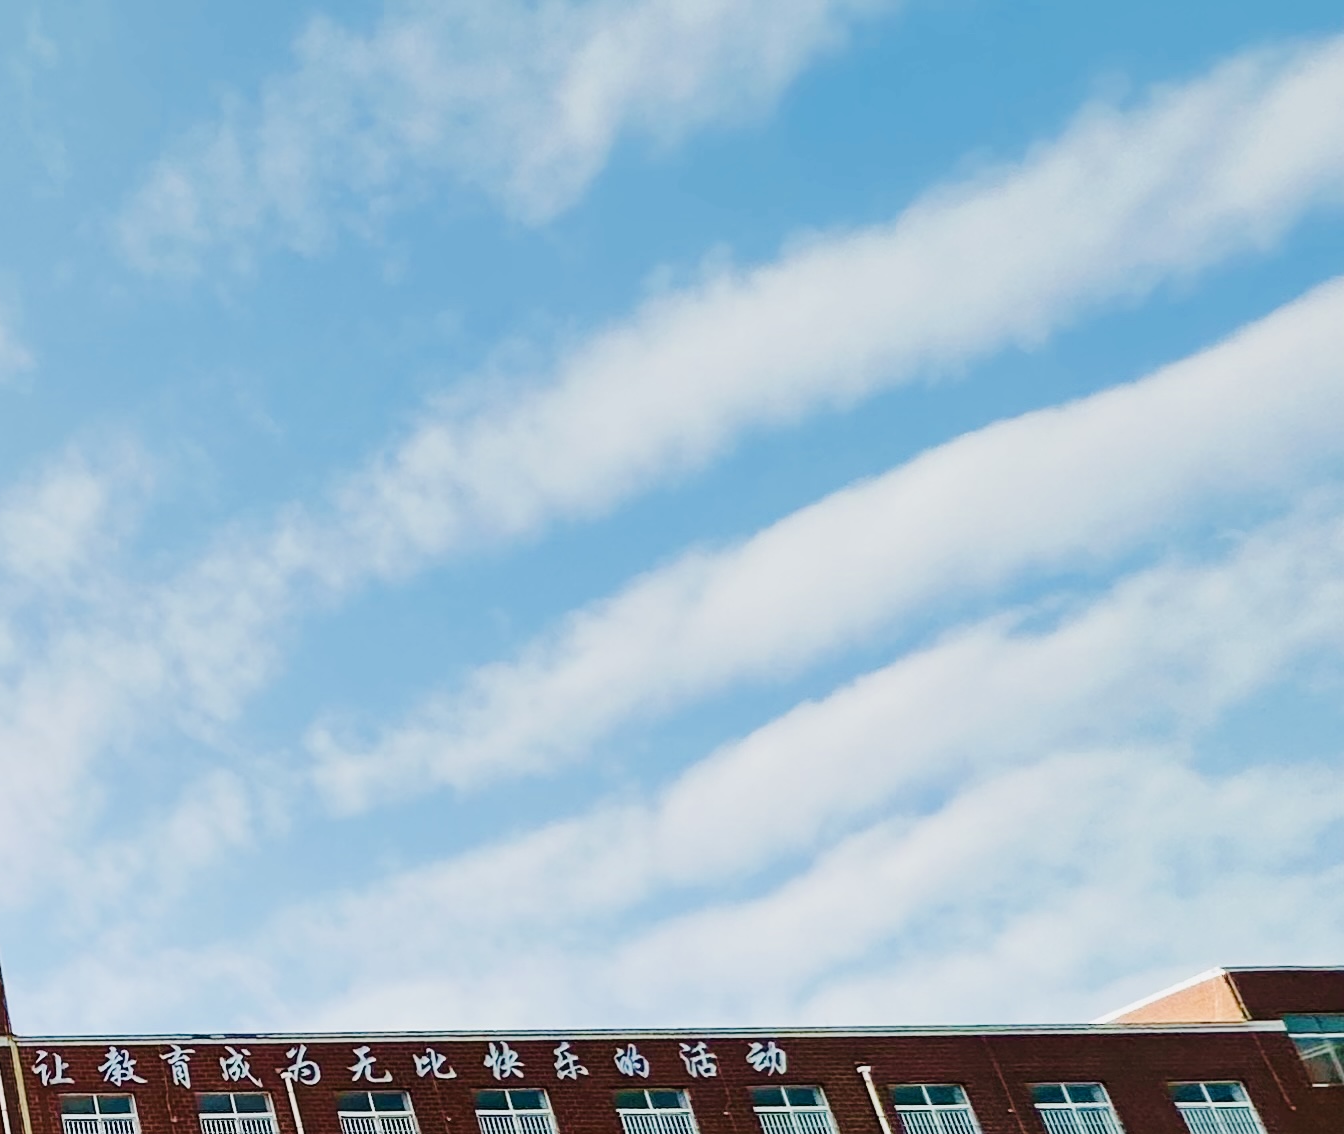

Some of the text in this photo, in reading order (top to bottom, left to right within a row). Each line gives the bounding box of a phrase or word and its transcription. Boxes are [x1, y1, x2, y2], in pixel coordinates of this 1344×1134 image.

[31, 1041, 788, 1089] 让教育成为无比快乐的活动
